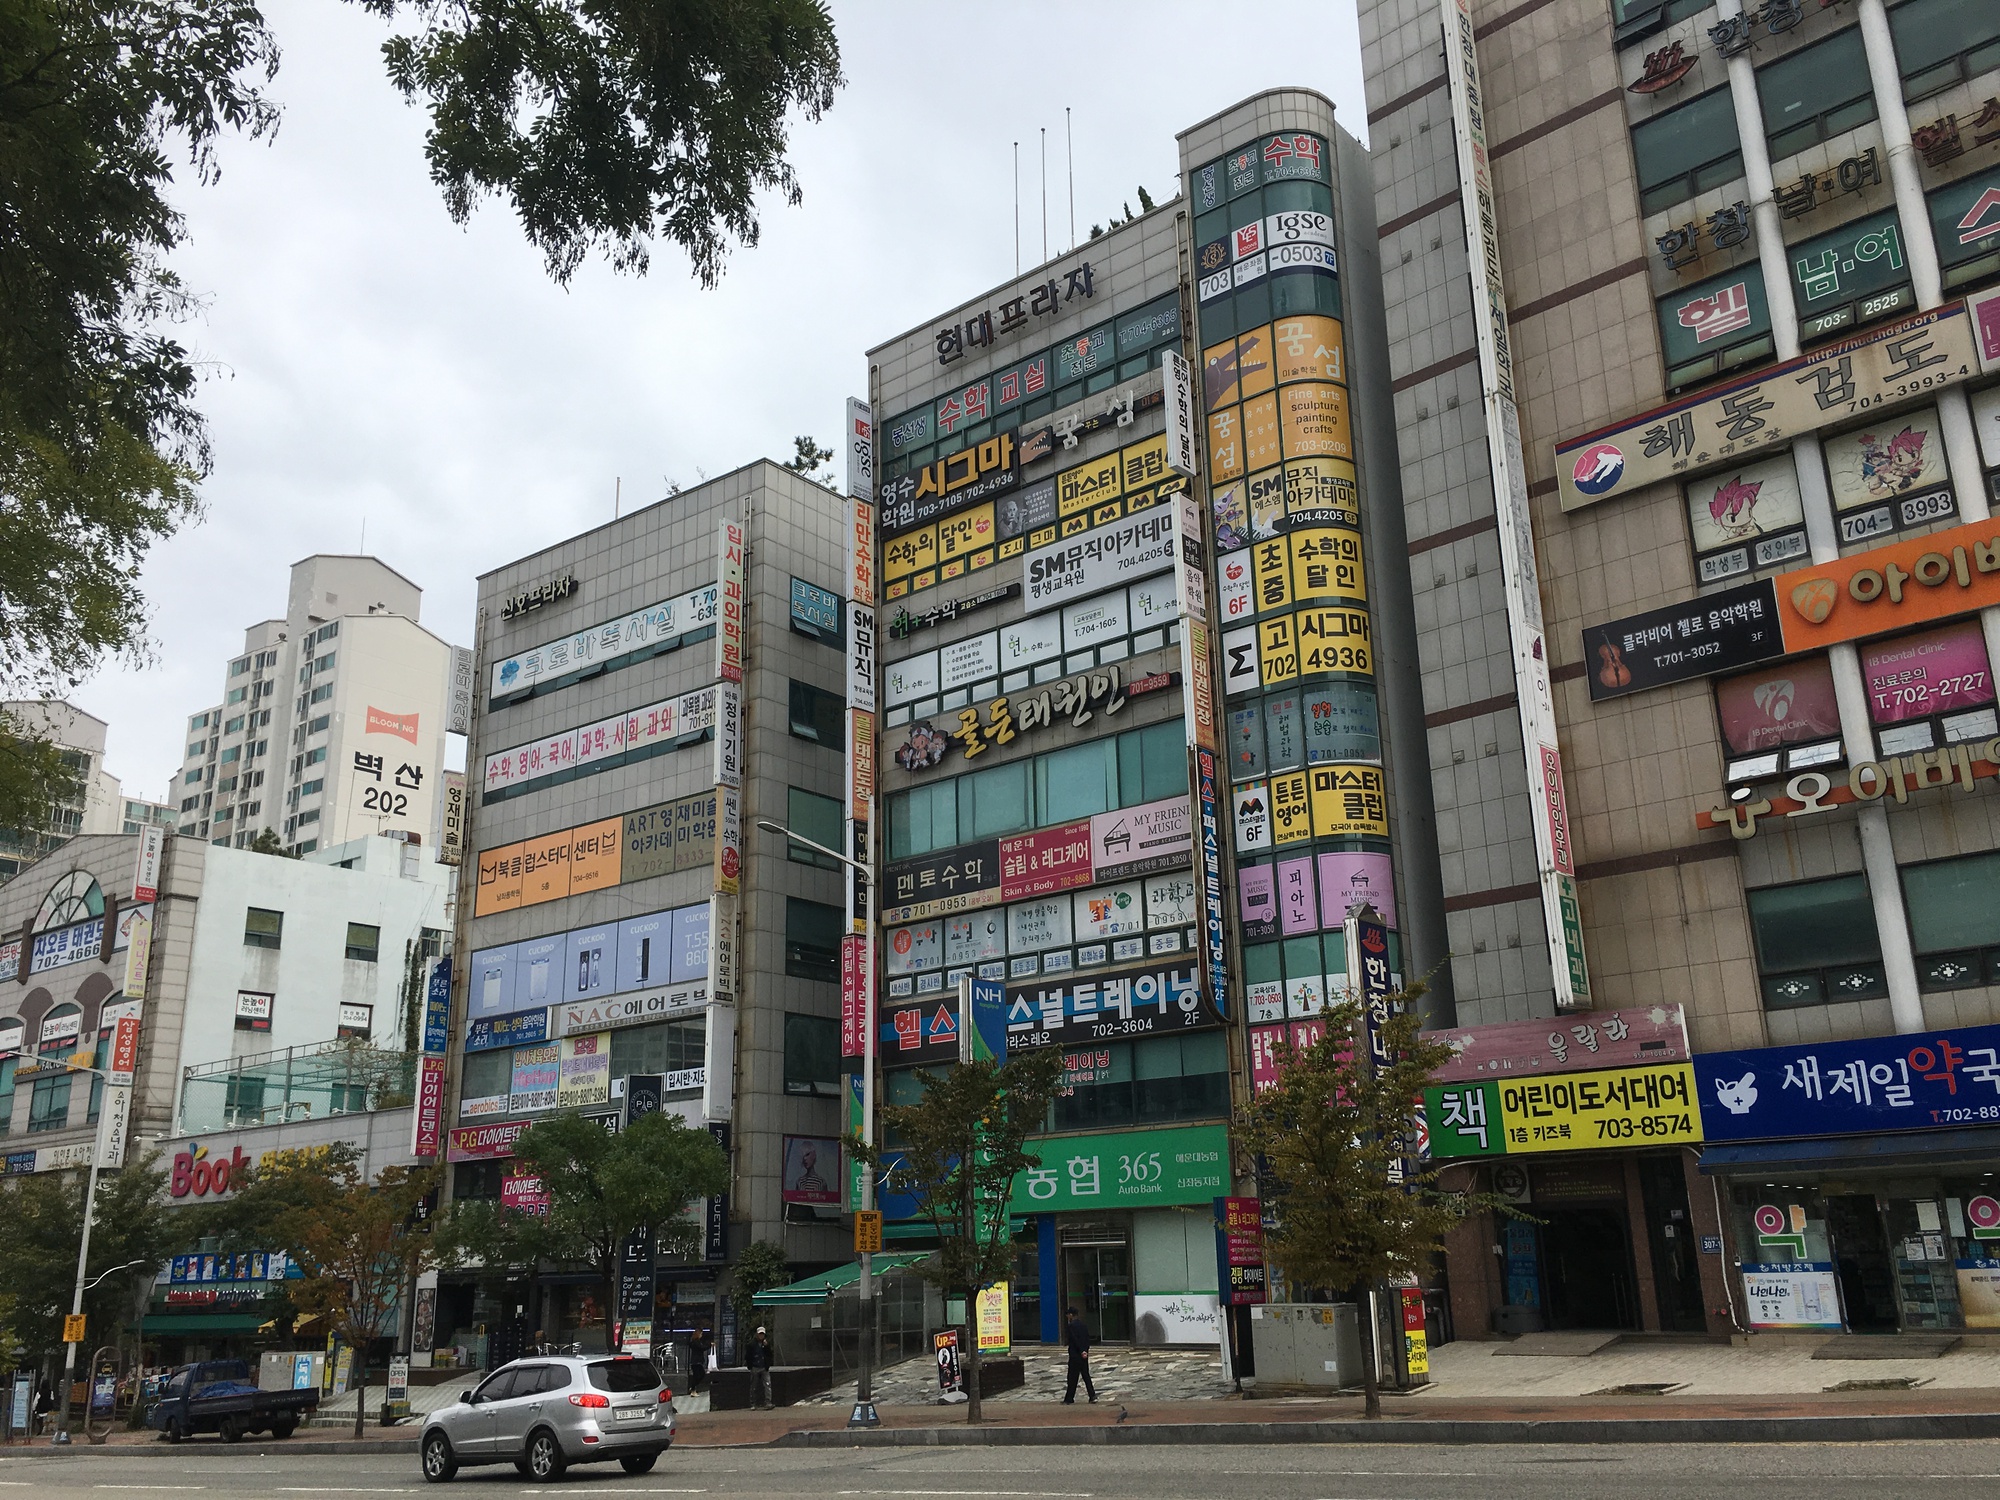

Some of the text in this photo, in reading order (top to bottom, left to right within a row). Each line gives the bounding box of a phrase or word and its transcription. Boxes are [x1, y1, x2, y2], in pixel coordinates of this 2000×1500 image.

[1264, 134, 1321, 169] 수학
[1265, 167, 1321, 181] T.704-6365
[1655, 200, 1750, 271] 한창
[1202, 246, 1323, 296] 703 -0503
[935, 262, 1096, 366] 현대프라자
[1678, 282, 1751, 344] 헬
[1865, 292, 1899, 317] 2525
[1119, 308, 1178, 345] T.704-6365
[1278, 322, 1340, 378] 꿈 섬
[1071, 353, 1096, 378] 전문
[939, 358, 1045, 434] 수학 교실
[1287, 388, 1340, 402] Fine arts
[1847, 364, 1969, 413] 704-3993-4
[1291, 401, 1340, 412] sculpture
[1296, 413, 1338, 426] painting
[1213, 412, 1236, 469] 꿈 섬
[1303, 423, 1333, 435] crafts
[1294, 440, 1347, 454] 703-0209
[881, 434, 1014, 505] 영수 시그마
[1286, 465, 1319, 489] 뮤직
[1062, 465, 1116, 502] 마스터
[1251, 474, 1282, 500] SM
[1287, 485, 1351, 507] 아카데미
[881, 502, 915, 528] 학원
[1290, 510, 1343, 525] 704.4205
[1844, 494, 1951, 542] 704- 3993
[887, 518, 973, 567] 수학의 달인
[1299, 535, 1358, 562] 수학의
[1117, 546, 1163, 571] 704.4205
[1030, 568, 1085, 599] 평생교육원
[1307, 564, 1355, 589] 달인
[501, 575, 571, 622] 신호프라자
[792, 579, 836, 611] 크로바
[1229, 595, 1247, 615] 6F
[854, 609, 873, 631] SM
[1074, 617, 1118, 638] T.704-1605
[1677, 598, 1764, 640] 첼로 음악학원
[1267, 613, 1368, 652] 고 시그마
[854, 632, 873, 686] 뮤직
[1654, 630, 1764, 669] T.701-3052 3F
[1881, 641, 1946, 665] Dental Clinic
[1264, 647, 1368, 680] 702 4936
[1129, 673, 1171, 696] 701-9559
[1872, 666, 1928, 691] 진료문의
[1875, 671, 1986, 710] T.702-2727
[369, 715, 415, 734] BLOOMING
[647, 706, 672, 736] 과외
[1761, 718, 1809, 736] Dental Clinic
[354, 750, 423, 791] 벽산
[1314, 770, 1380, 792] 마스터
[363, 786, 408, 816] 202
[1276, 777, 1305, 805] 튼튼
[446, 786, 462, 846] 영재미술
[1276, 802, 1307, 828] 영어
[1343, 792, 1384, 822] 클럽
[627, 812, 657, 836] ART
[1134, 815, 1150, 827] MY
[1148, 819, 1182, 835] MUSIC
[1246, 825, 1263, 842] 6F
[574, 836, 600, 862] 센터
[723, 828, 738, 847] 수학
[1004, 840, 1089, 878] 슬림 & 레그케어
[1158, 854, 1187, 868] 701.3050
[897, 859, 984, 900] 멘토수학
[1004, 878, 1055, 898] Skin Body
[914, 896, 967, 917] 701-0953
[1289, 869, 1307, 924] 피아노
[1341, 889, 1380, 898] MY FRIEND
[578, 933, 606, 945] CUCKOO
[630, 922, 659, 935] CUCKOO
[1246, 924, 1275, 937] 701-3050
[37, 943, 100, 970] 702-4666
[975, 986, 1002, 1004] NH
[893, 1003, 957, 1052] 헬스
[1092, 1011, 1200, 1038] 702-3604 2F
[1260, 1009, 1273, 1020] 7층
[420, 1071, 438, 1145] 다이어트댄스
[469, 1100, 499, 1114] aerobics
[1441, 1071, 1691, 1149] 책 어린이도서대여
[1510, 1113, 1692, 1143] 1층 키즈북 703-8574
[1026, 1151, 1162, 1200] 농협 365
[1118, 1183, 1163, 1195] Auto Bank
[390, 1369, 406, 1377] OPEN
